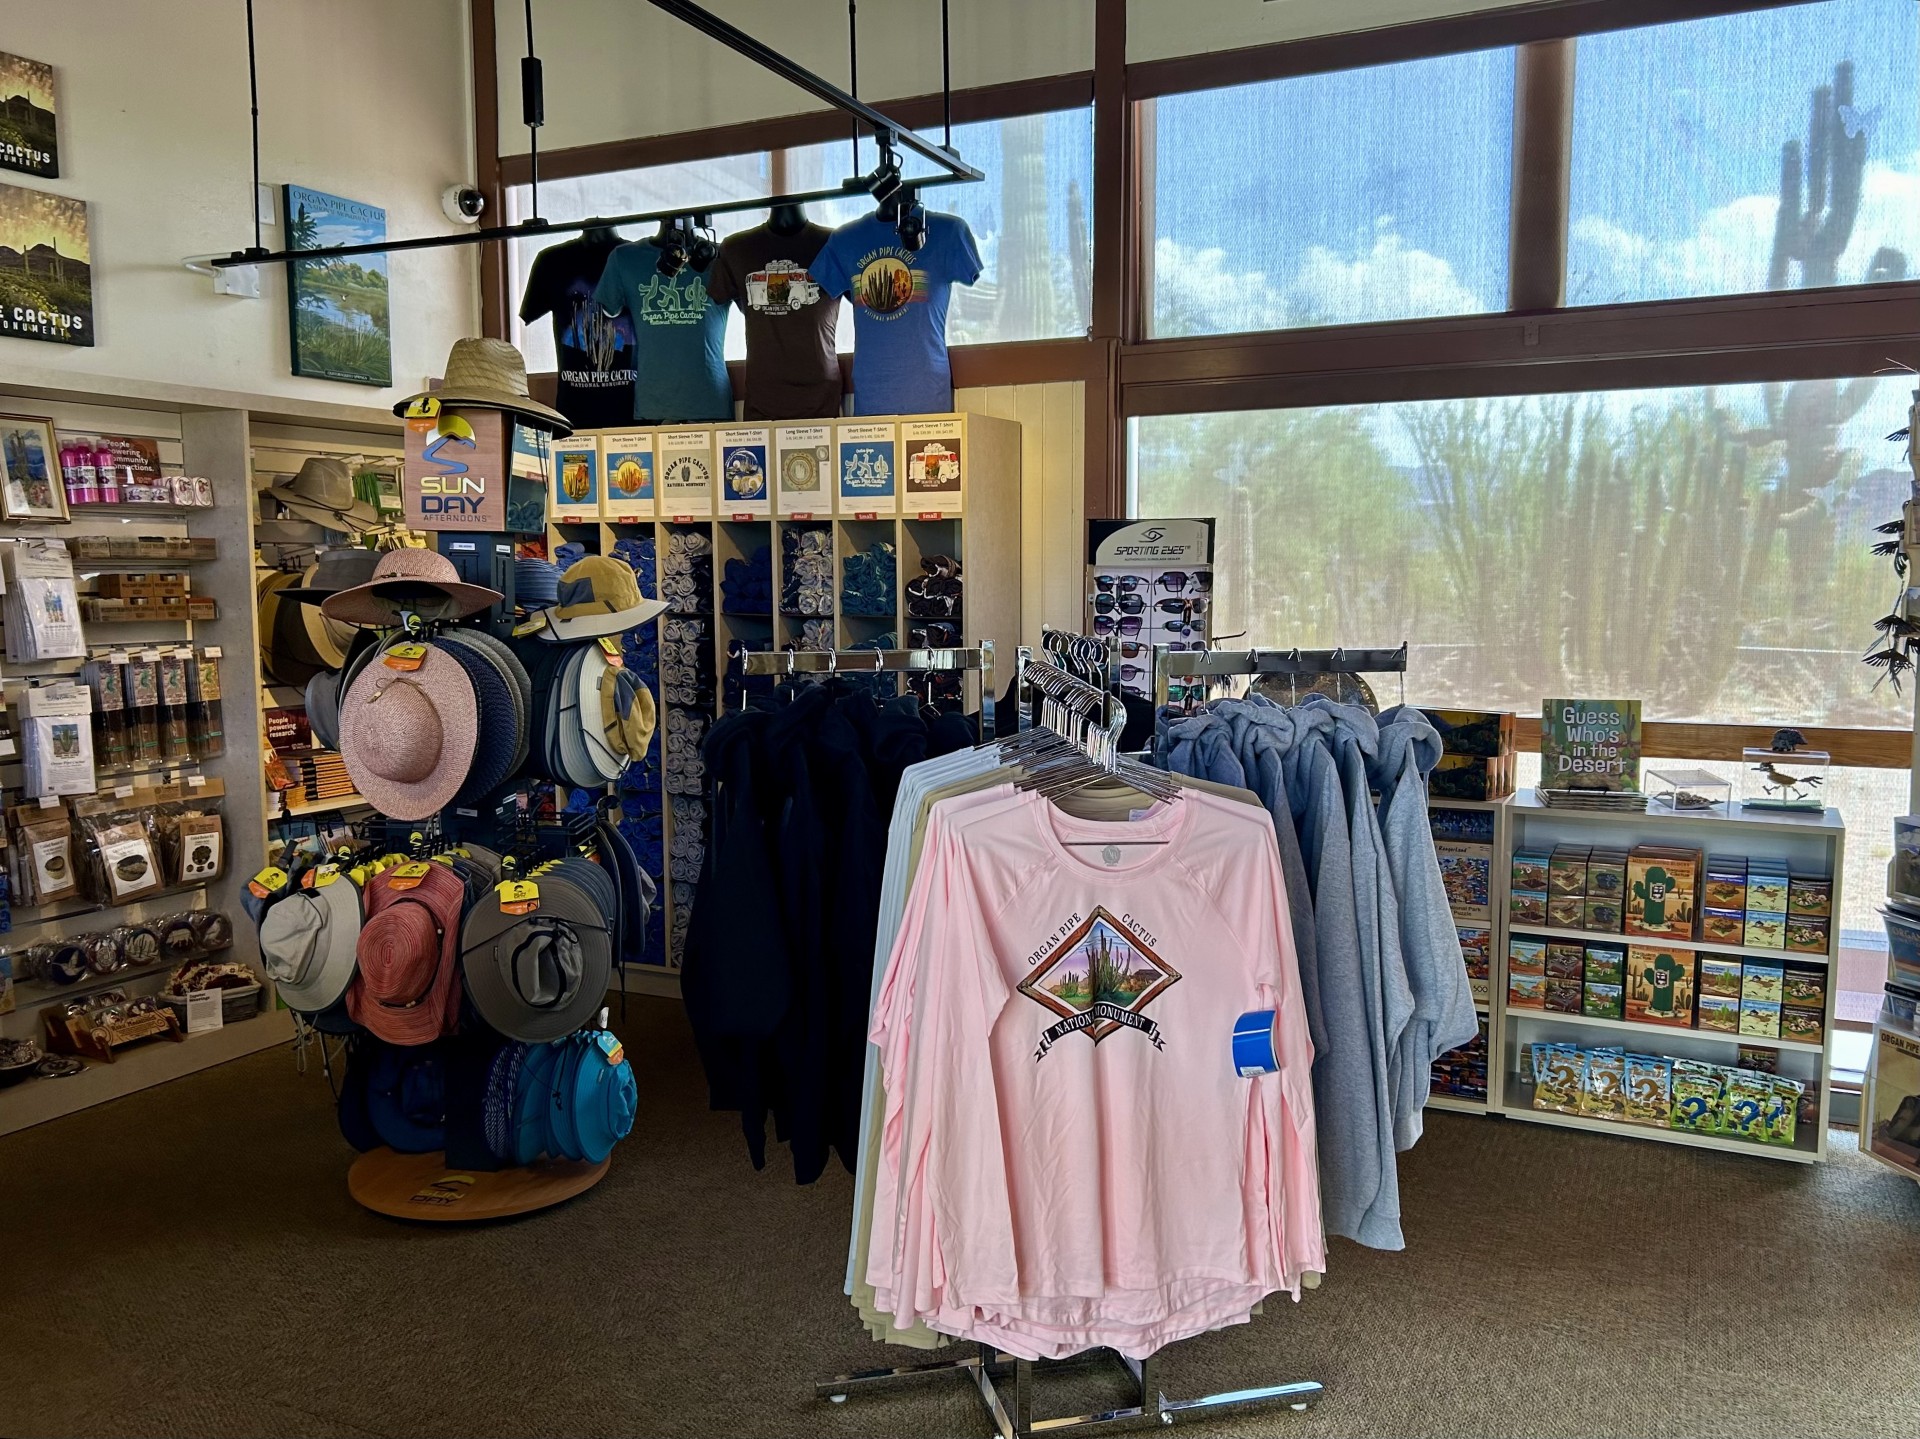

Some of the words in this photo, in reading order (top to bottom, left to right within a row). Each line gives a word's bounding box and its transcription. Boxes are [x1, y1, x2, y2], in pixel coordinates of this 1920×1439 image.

[0, 142, 50, 163] CACTUS
[293, 190, 328, 207] ORGAN
[350, 205, 385, 221] CACTUS
[857, 249, 878, 269] ORGAN
[880, 246, 894, 256] PIPE
[895, 247, 917, 265] CACTUS
[13, 307, 83, 330] CACTUS
[643, 313, 662, 321] Organ
[663, 311, 679, 319] Pipe
[680, 311, 704, 319] Cactus
[3, 320, 65, 337] ONUMENT
[561, 370, 590, 382] ORGAN
[591, 371, 610, 382] PIPE
[610, 369, 638, 381] CACTUS
[106, 439, 130, 448] People
[112, 463, 155, 472] onnctions.
[113, 456, 149, 465] ommunity
[664, 459, 678, 480] ORGAN
[678, 456, 691, 464] PIPE
[692, 458, 710, 480] CACTUS
[420, 476, 485, 494] SUN
[420, 496, 485, 514] DAY
[423, 514, 487, 523] AFTERNOONS
[1114, 545, 1159, 555] SPORTING
[268, 717, 288, 725] People
[1562, 706, 1620, 725] Guess
[269, 723, 297, 732] powering
[269, 730, 296, 738] research.
[1566, 725, 1620, 743] Who's
[1573, 744, 1586, 757] in
[1590, 743, 1617, 757] the
[1558, 754, 1627, 773] Desert
[1027, 933, 1060, 966] ORGAN
[1059, 912, 1082, 937] PIPE
[1122, 913, 1158, 948] CACTUS
[1473, 985, 1488, 993] 500
[1055, 1010, 1094, 1036] NATION
[1881, 1033, 1905, 1048] ORGAN
[1905, 1041, 1920, 1054] PIPE
